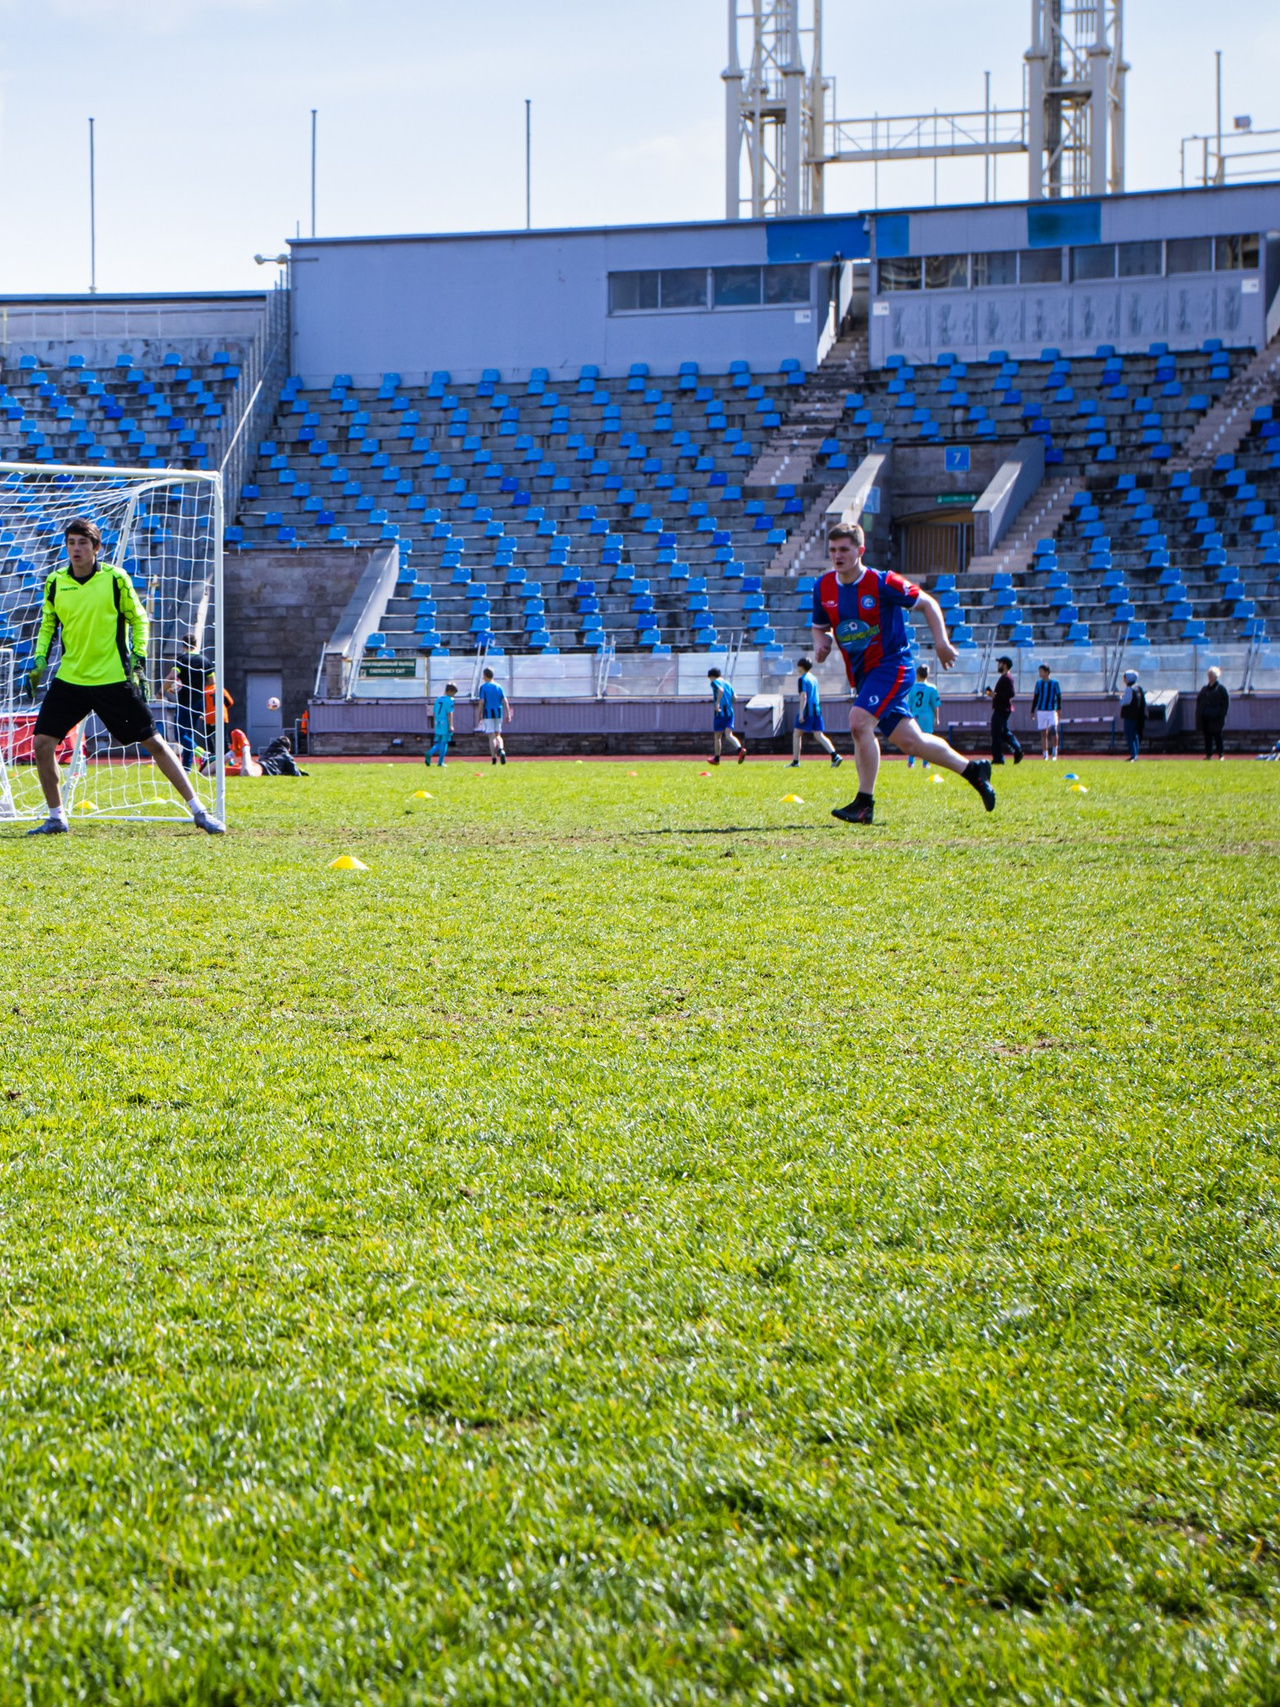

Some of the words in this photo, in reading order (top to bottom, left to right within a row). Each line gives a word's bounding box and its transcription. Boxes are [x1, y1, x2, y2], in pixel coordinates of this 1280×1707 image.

[953, 452, 962, 464] 7
[868, 695, 880, 706] 9
[915, 691, 924, 708] 3
[438, 701, 444, 715] 7
